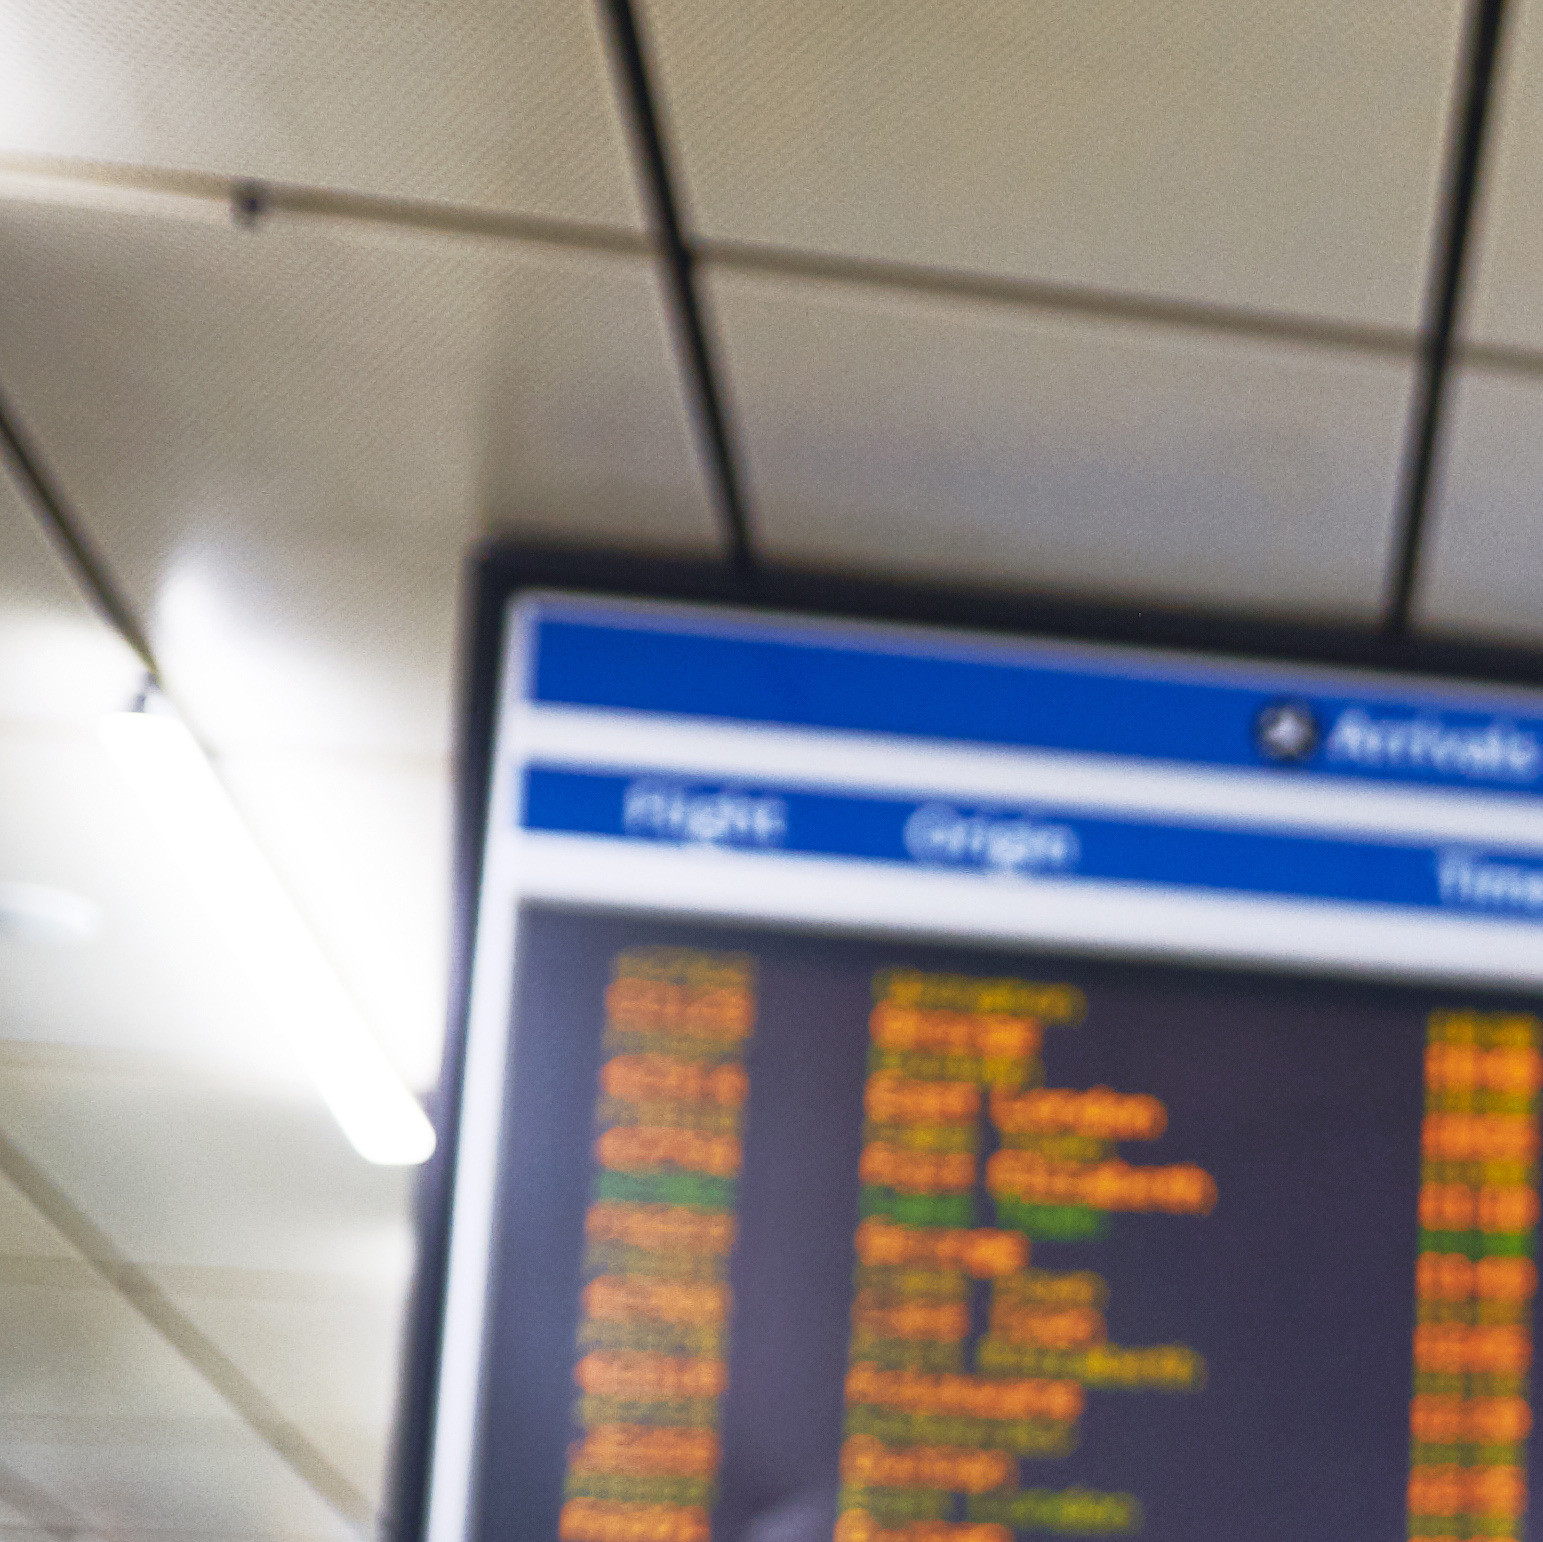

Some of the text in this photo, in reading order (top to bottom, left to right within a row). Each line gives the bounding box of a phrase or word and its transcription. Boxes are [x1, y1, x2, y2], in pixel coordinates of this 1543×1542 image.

[1325, 706, 1543, 778] Arrivals
[624, 773, 786, 848] Flight
[905, 804, 1078, 880] Origin
